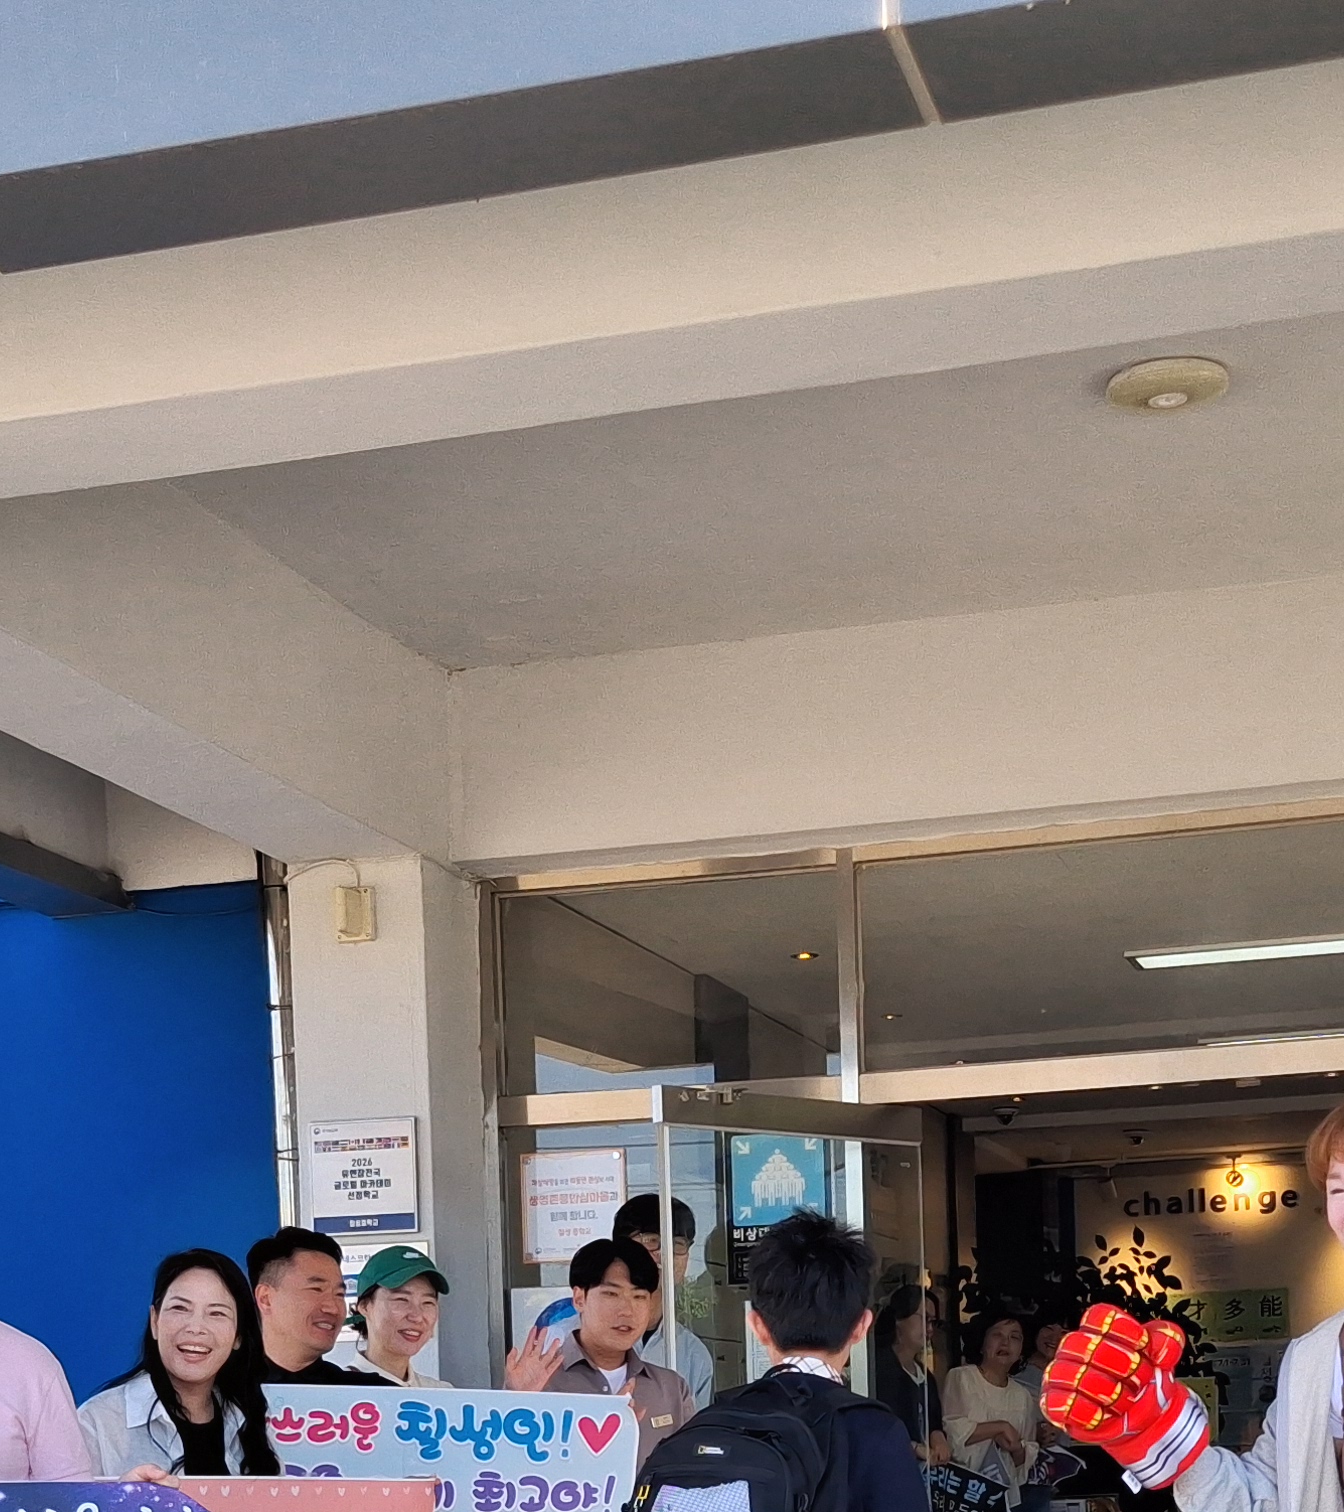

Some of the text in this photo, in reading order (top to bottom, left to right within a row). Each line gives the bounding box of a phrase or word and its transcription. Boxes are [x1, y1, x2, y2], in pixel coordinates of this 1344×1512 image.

[351, 1157, 373, 1167] 2026
[1123, 1187, 1299, 1217] challenge
[265, 1399, 575, 1463] 스러운 칠성인!
